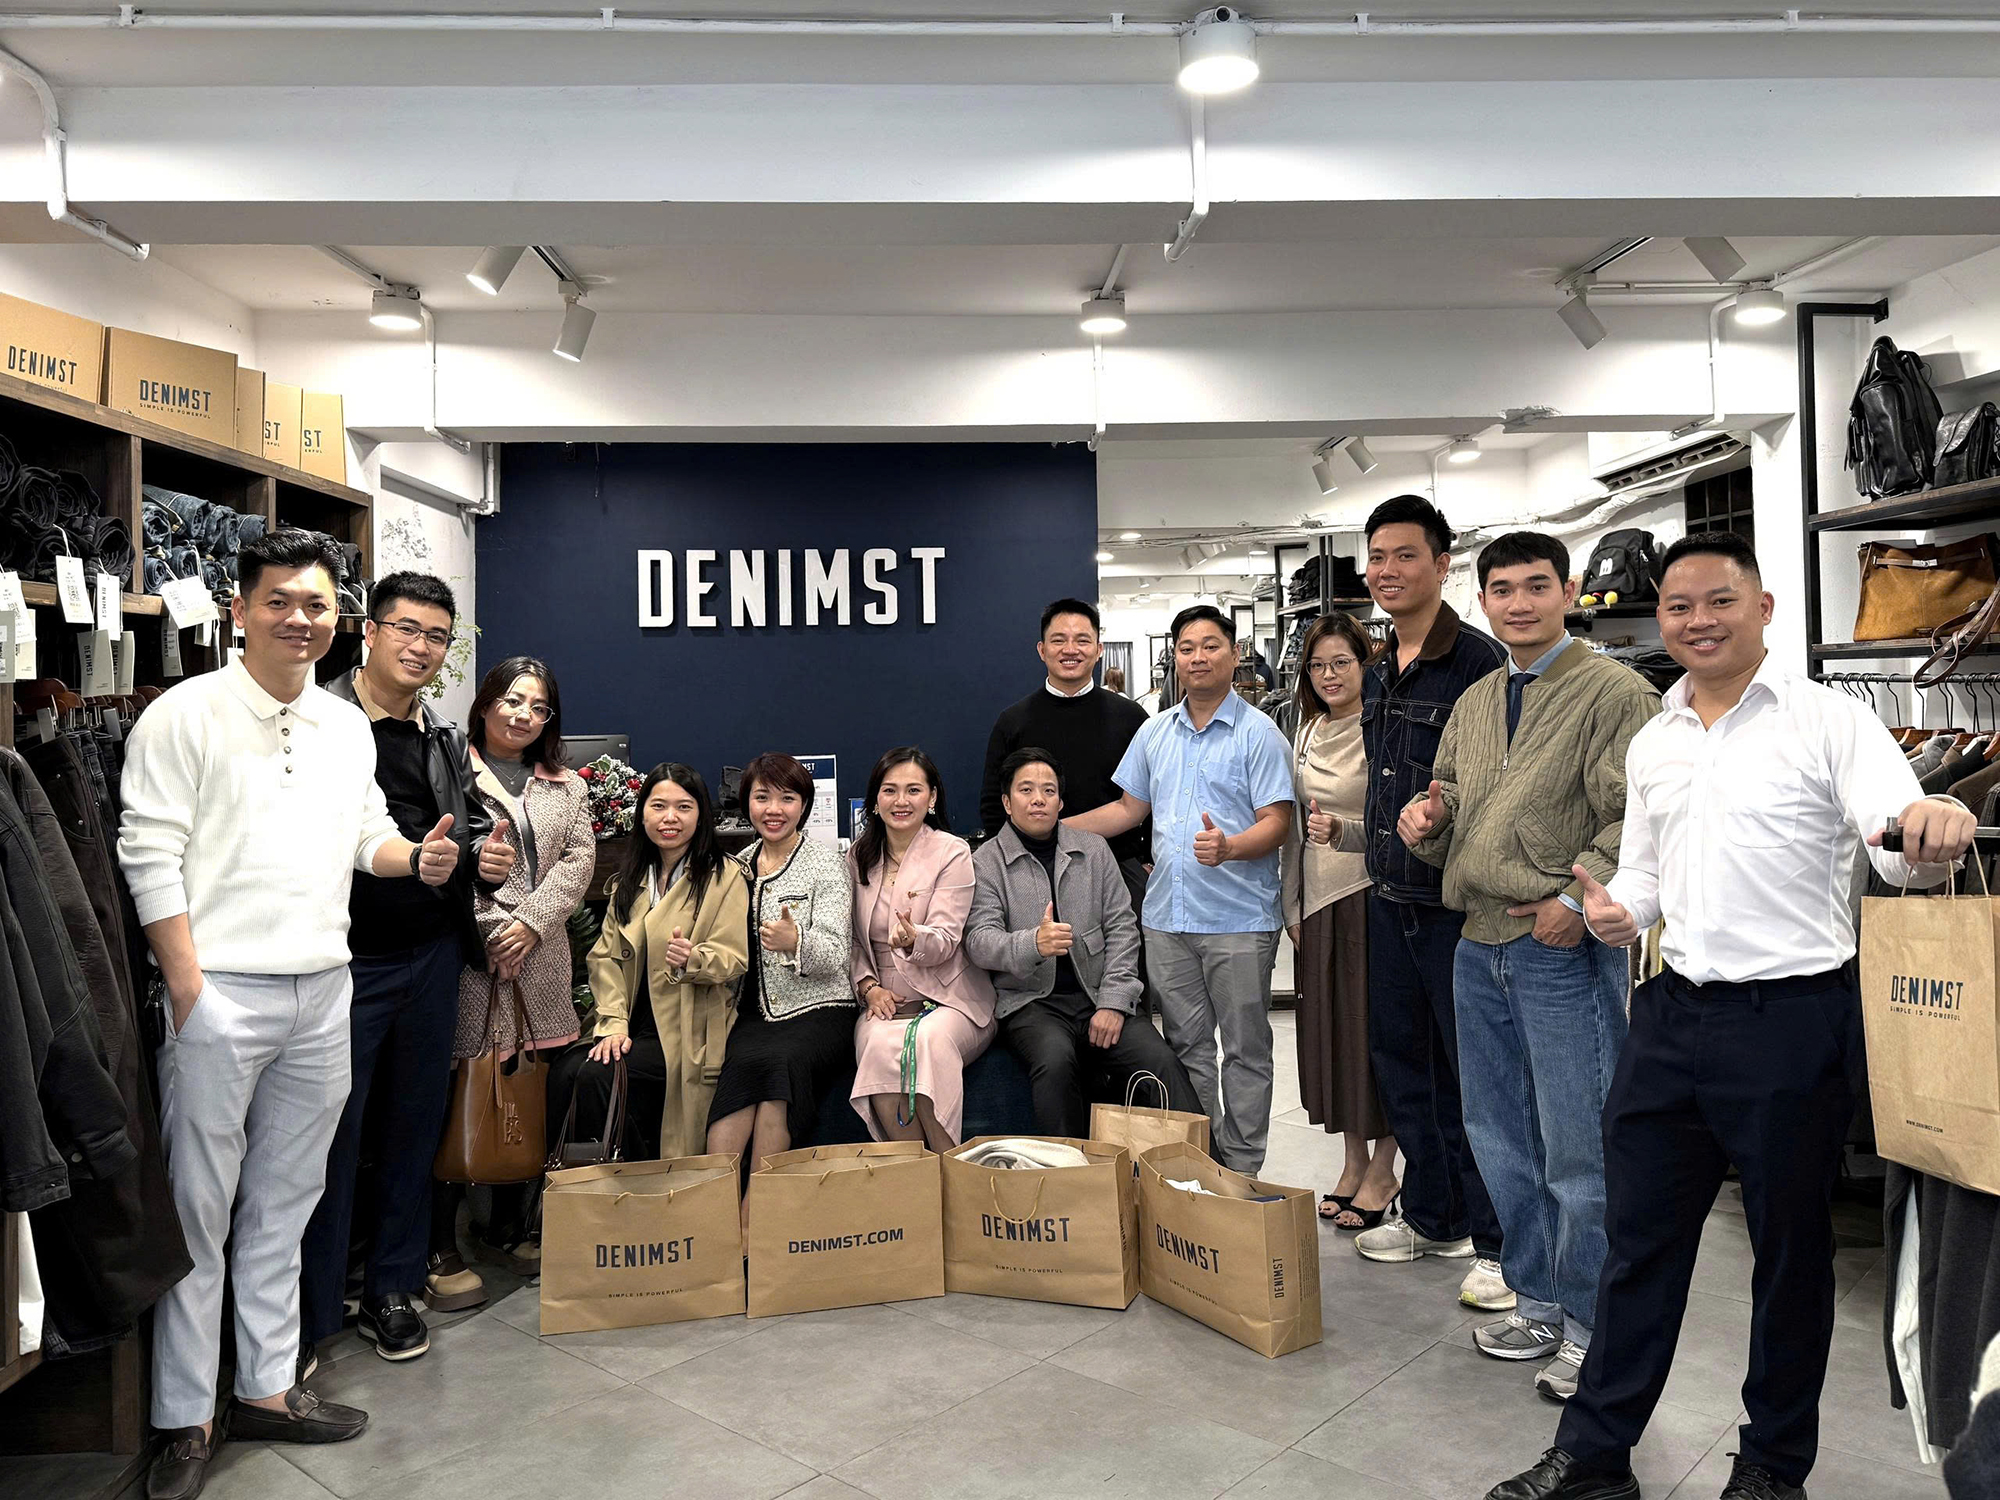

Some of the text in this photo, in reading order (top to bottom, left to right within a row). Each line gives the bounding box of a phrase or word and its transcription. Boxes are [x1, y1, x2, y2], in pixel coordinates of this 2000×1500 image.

[7, 345, 78, 386] DENIMST
[139, 379, 211, 413] DENIMST
[139, 402, 164, 411] SIMPLE
[177, 409, 211, 420] POWERFUL
[637, 547, 946, 628] DENIMST
[83, 645, 93, 677] DENIMST
[1890, 975, 1964, 1011] DENIMST
[1889, 1005, 1912, 1015] SIMPLE
[1928, 1011, 1961, 1021] POWERFUL
[788, 1227, 904, 1254] DENIMST.COM
[982, 1213, 1070, 1242] DENIMST
[596, 1236, 695, 1268] DENIMST
[1156, 1223, 1220, 1274] DENIMST
[646, 1288, 684, 1297] POWERFUL
[1272, 1257, 1285, 1299] DENIMST
